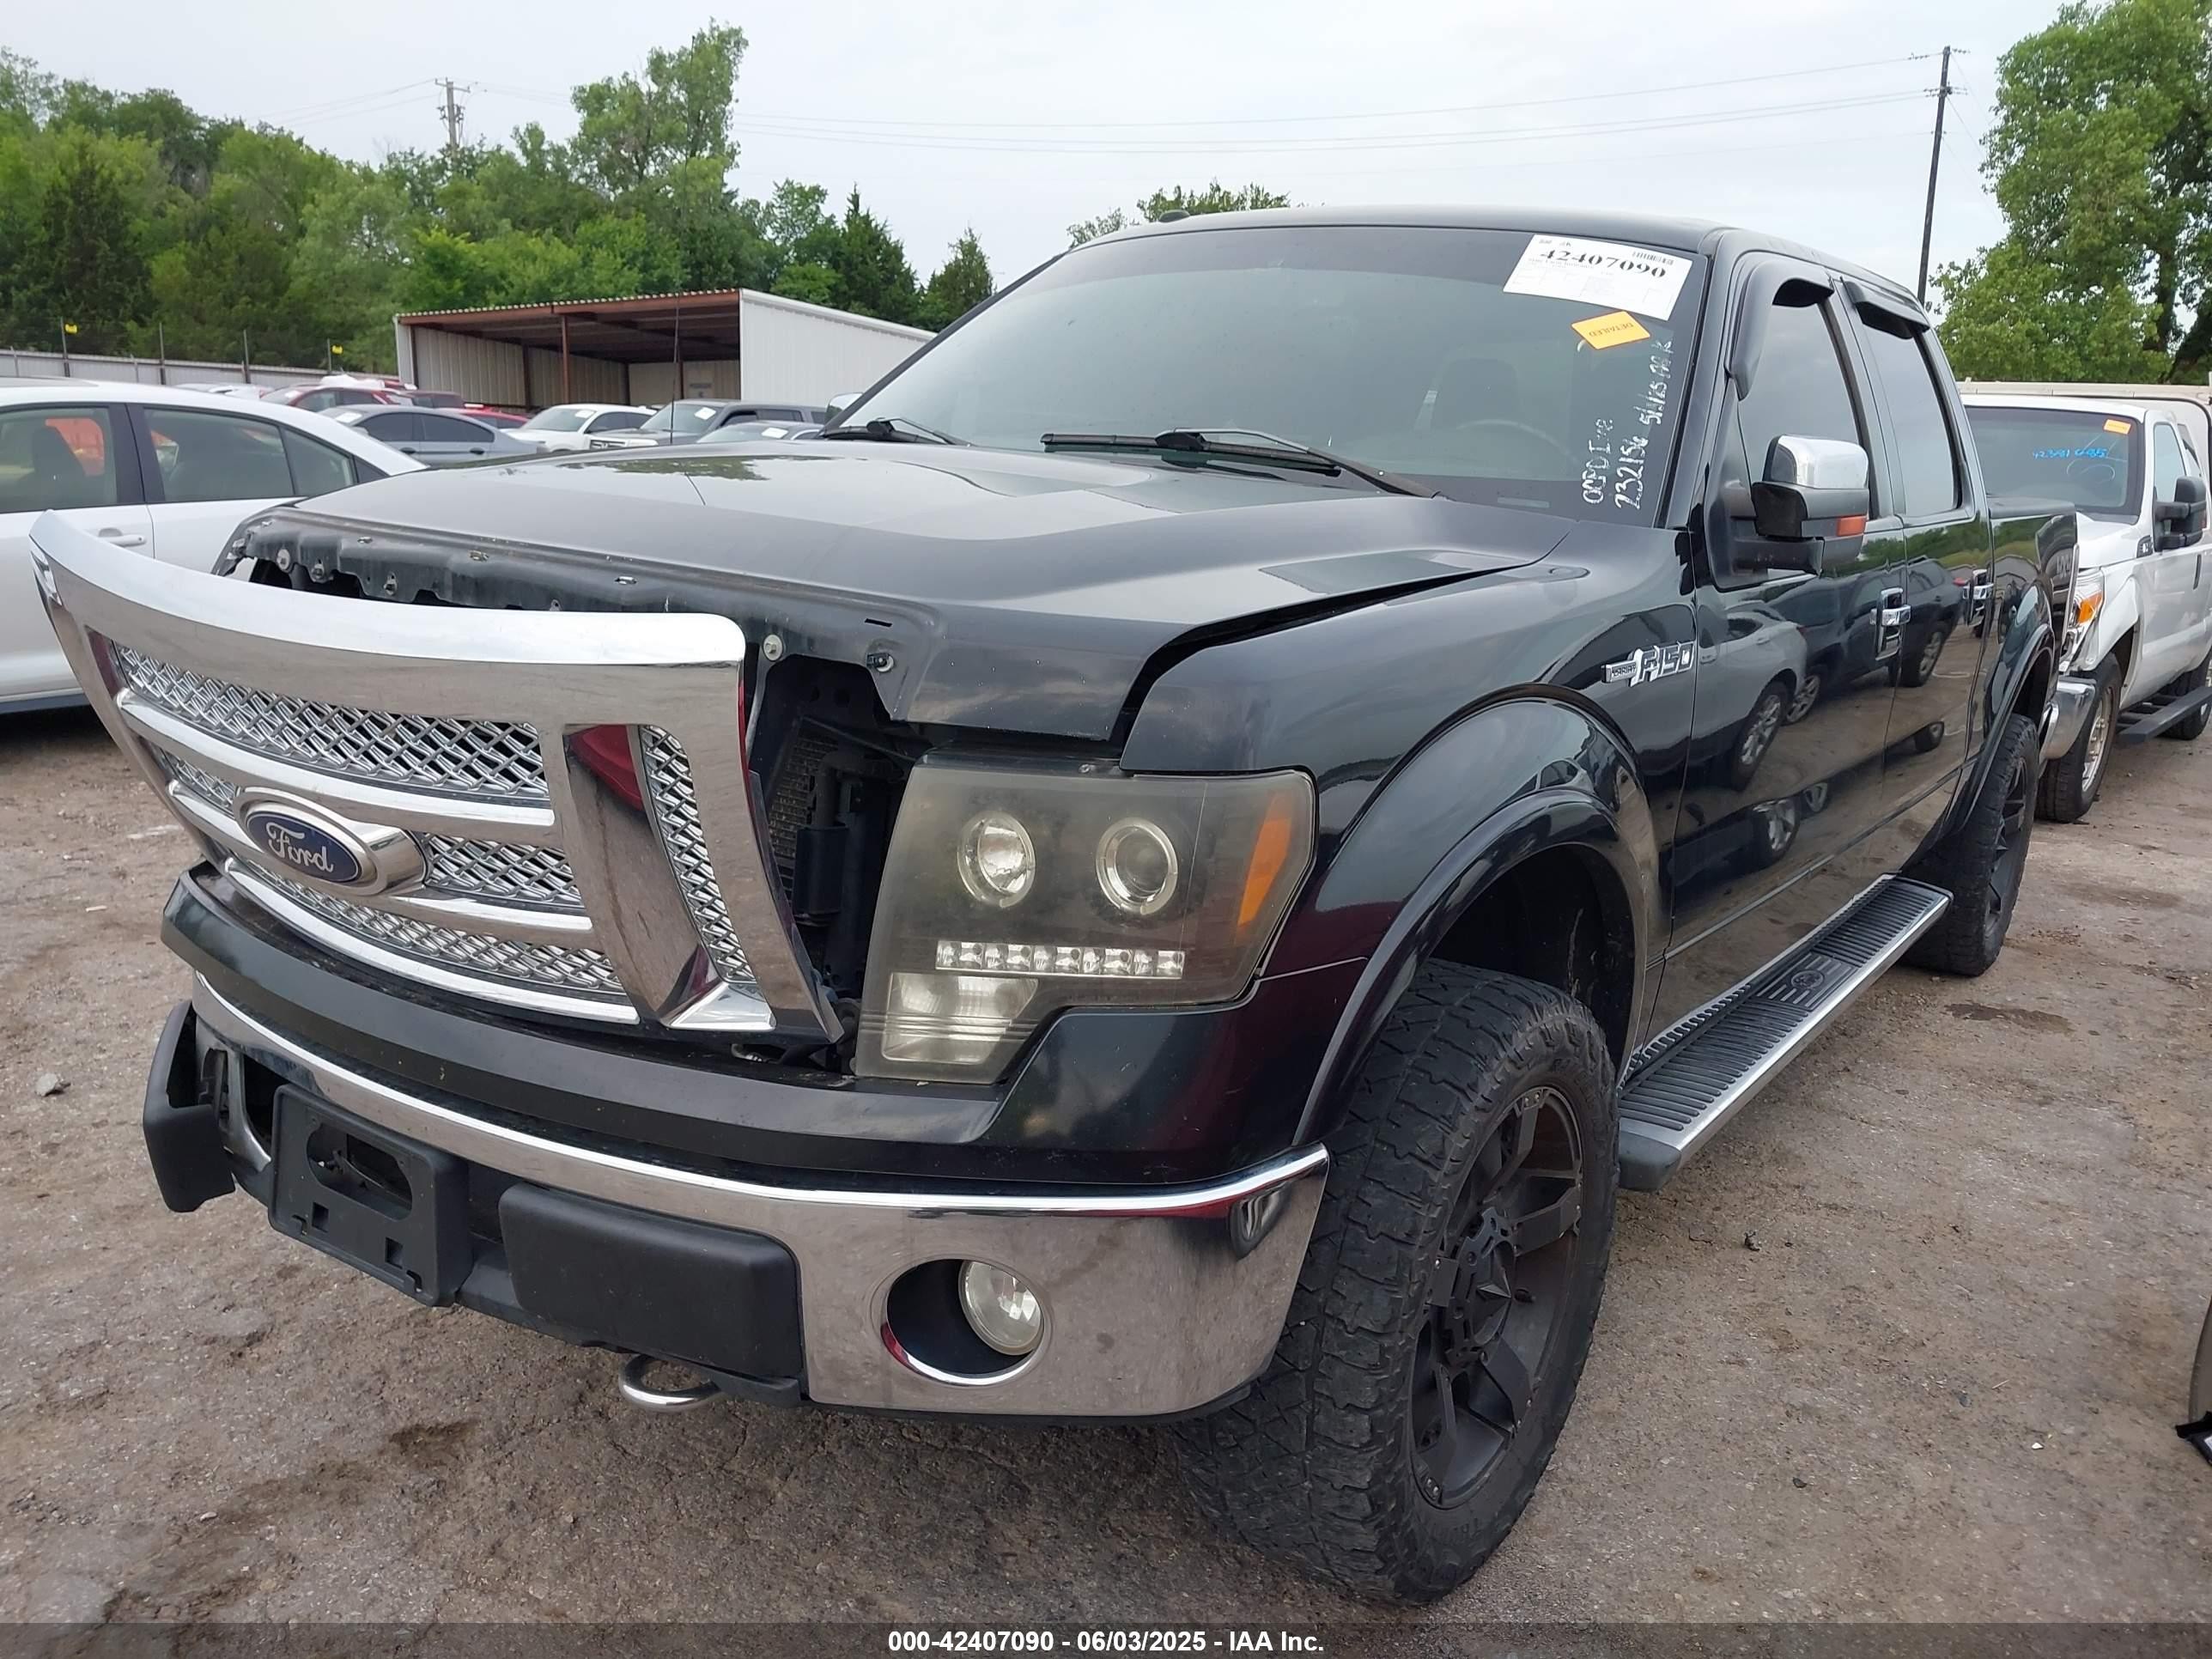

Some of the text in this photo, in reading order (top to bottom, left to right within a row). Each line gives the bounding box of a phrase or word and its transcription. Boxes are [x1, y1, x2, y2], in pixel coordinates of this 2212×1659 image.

[1540, 252, 1666, 278] 42407090
[1588, 322, 1633, 338] DETAILED
[265, 821, 334, 873] Ford
